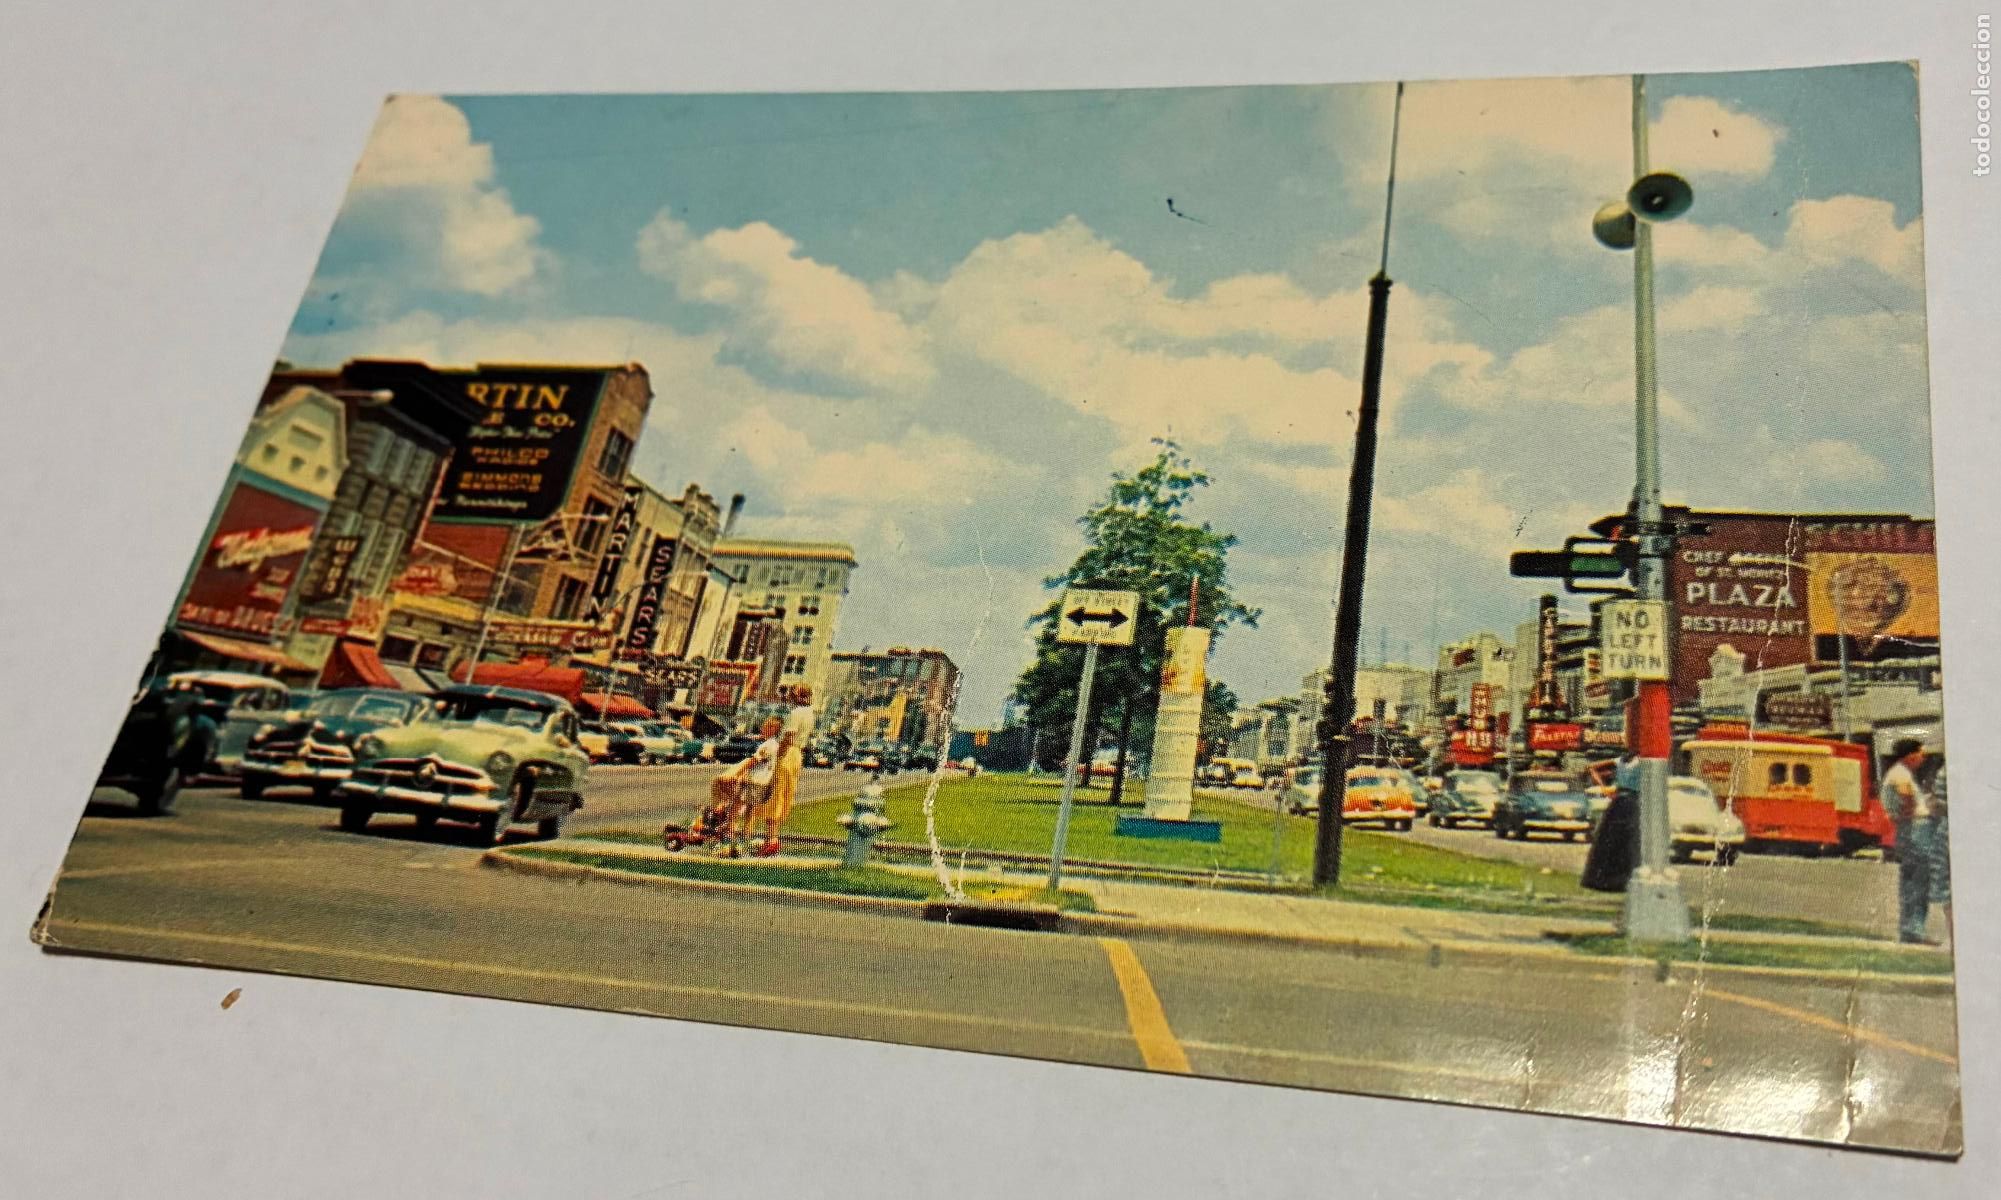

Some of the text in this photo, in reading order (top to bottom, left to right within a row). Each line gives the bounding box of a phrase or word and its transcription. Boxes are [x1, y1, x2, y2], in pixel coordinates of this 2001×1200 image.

[467, 382, 569, 409] RTIN
[534, 412, 575, 428] CO.
[471, 447, 550, 460] PHILCO
[590, 491, 641, 618] MARTIN
[631, 546, 672, 646] SEARS
[1686, 582, 1796, 607] PLAZA
[1617, 610, 1649, 628] NO
[1681, 615, 1805, 634] RESTAURANT
[1610, 634, 1657, 649] LEFT
[1607, 653, 1662, 669] TURN
